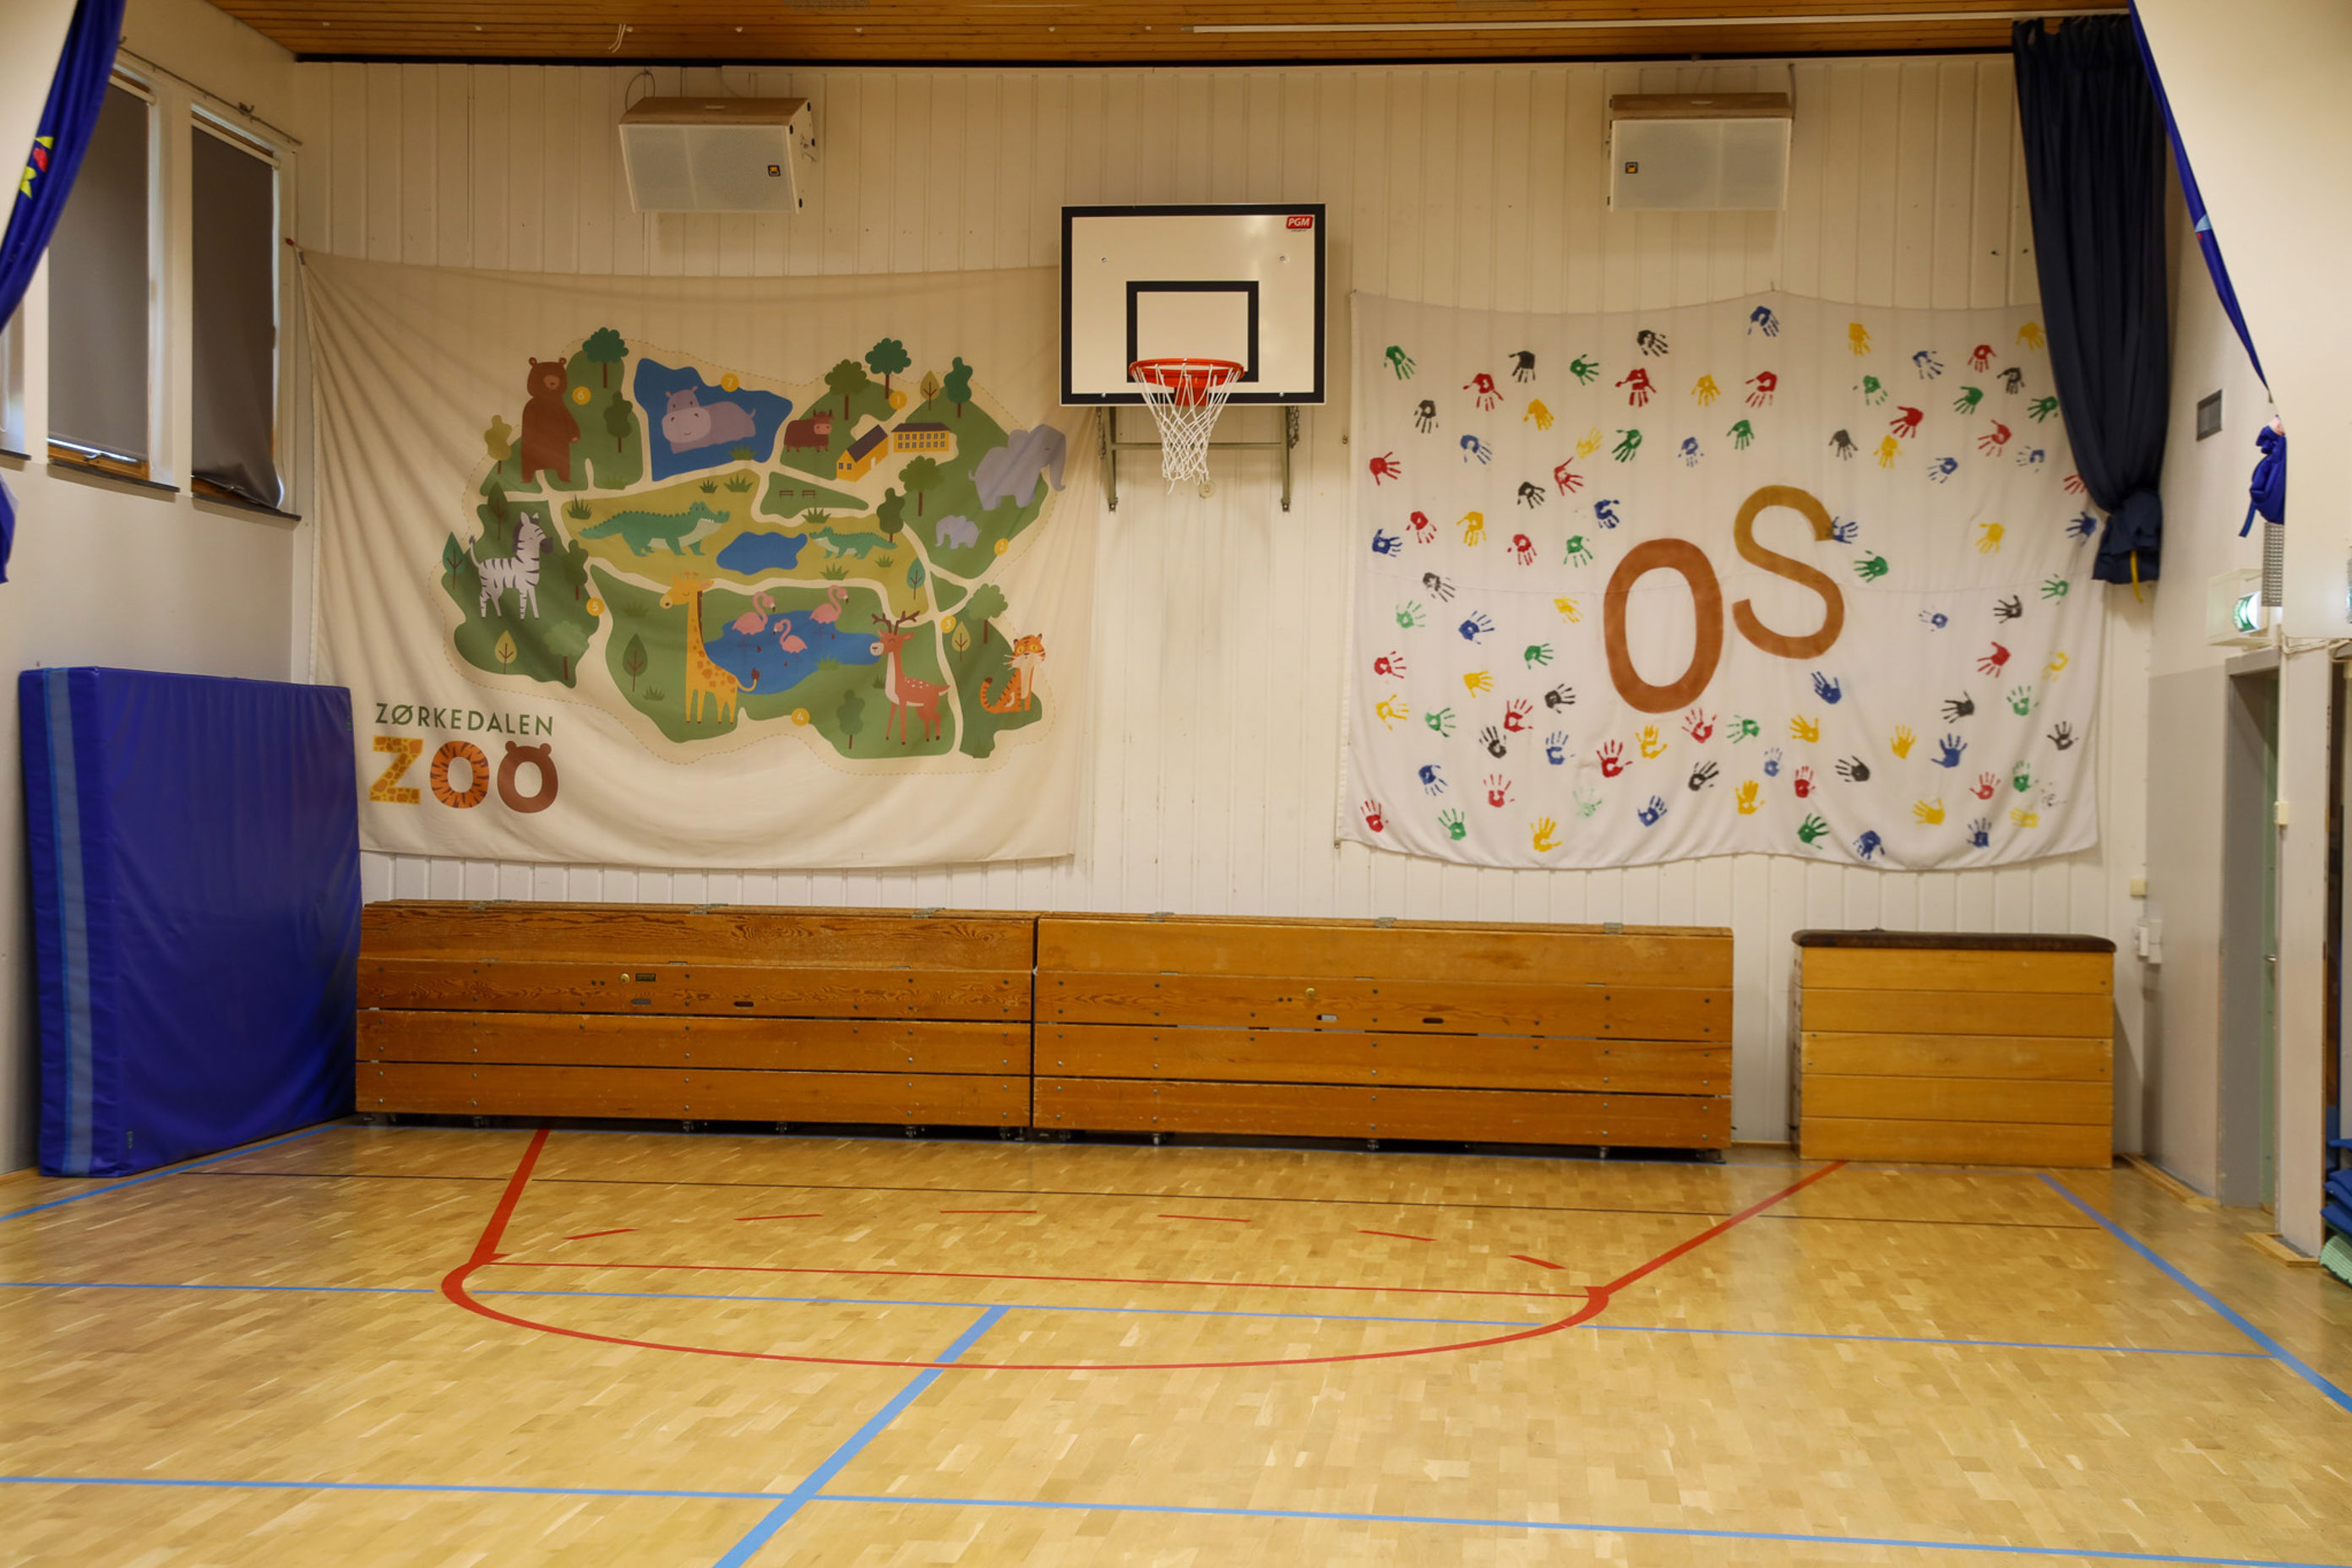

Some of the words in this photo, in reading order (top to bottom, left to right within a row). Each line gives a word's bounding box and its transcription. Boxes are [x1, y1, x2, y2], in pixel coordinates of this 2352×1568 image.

[1288, 218, 1310, 226] PGM
[375, 702, 553, 736] ZØRKEDALEN
[369, 735, 558, 814] ZOO
